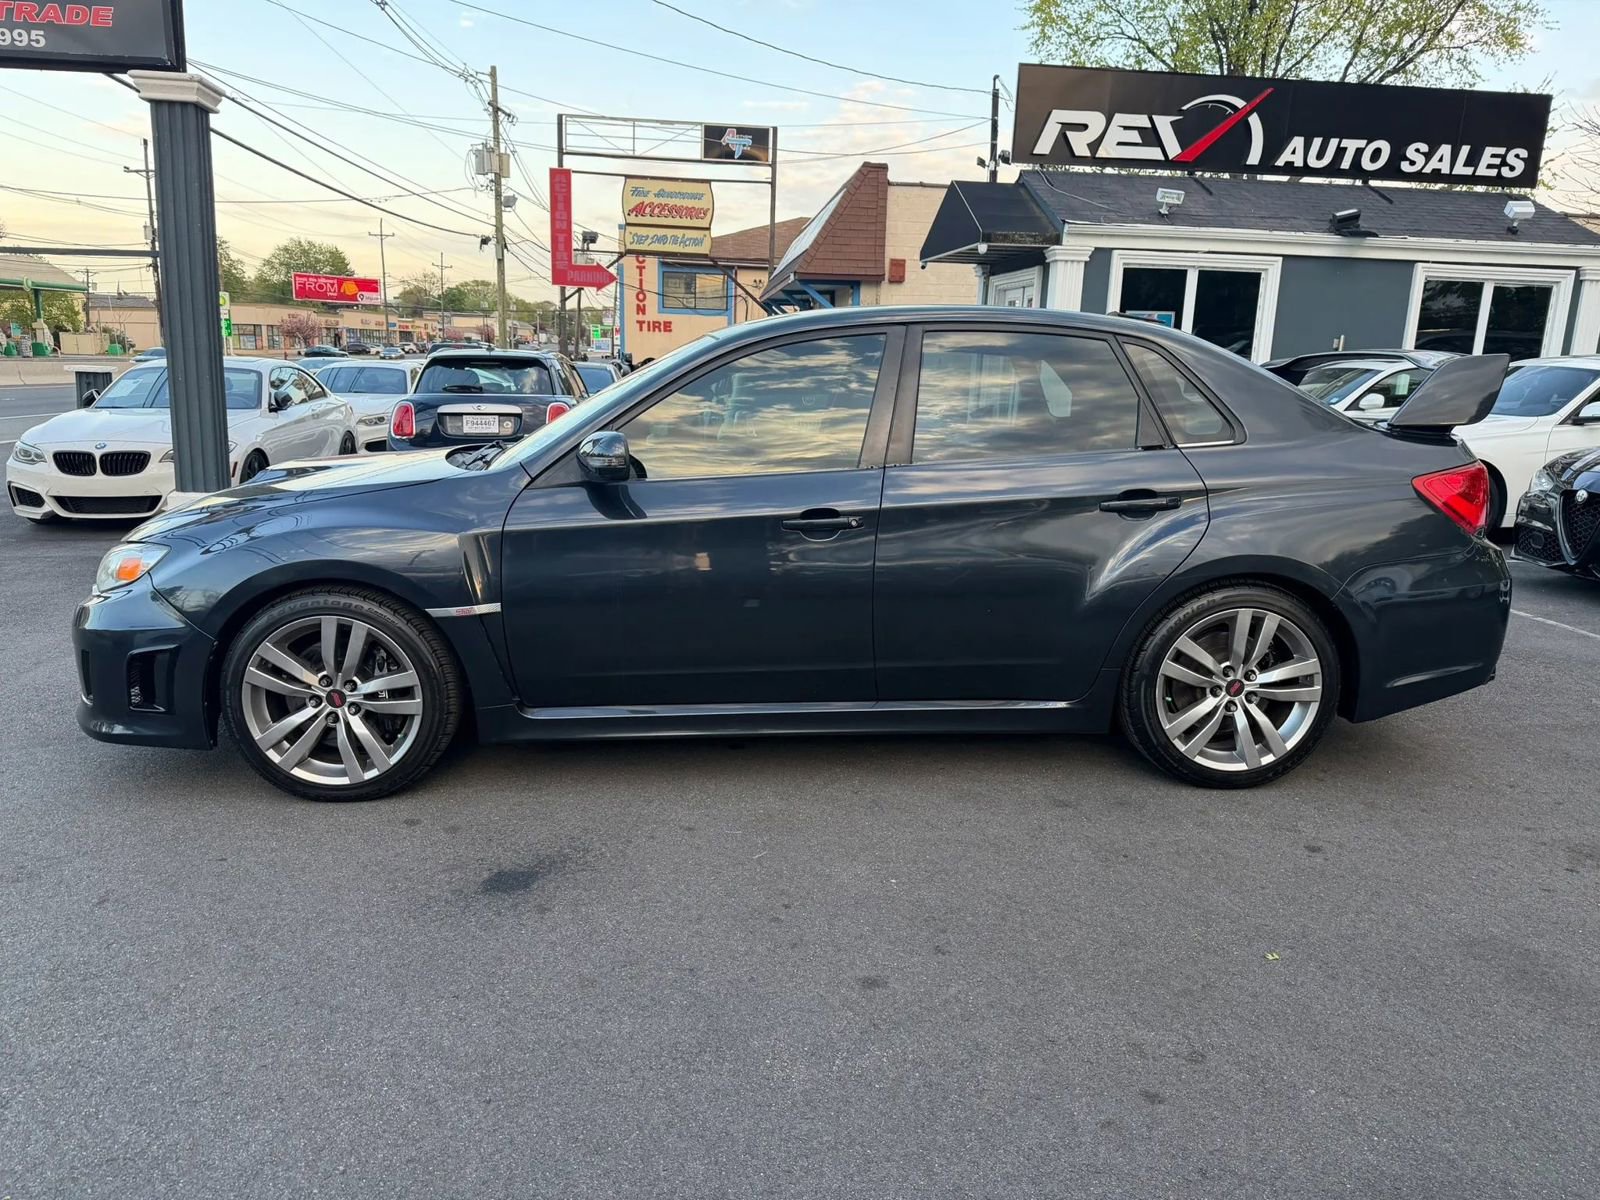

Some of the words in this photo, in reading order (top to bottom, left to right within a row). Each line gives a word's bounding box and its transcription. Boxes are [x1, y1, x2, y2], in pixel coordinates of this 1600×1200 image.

[1274, 136, 1391, 171] AUTO
[1400, 142, 1528, 178] SALES
[295, 281, 338, 293] FROM
[635, 320, 673, 332] TIRE
